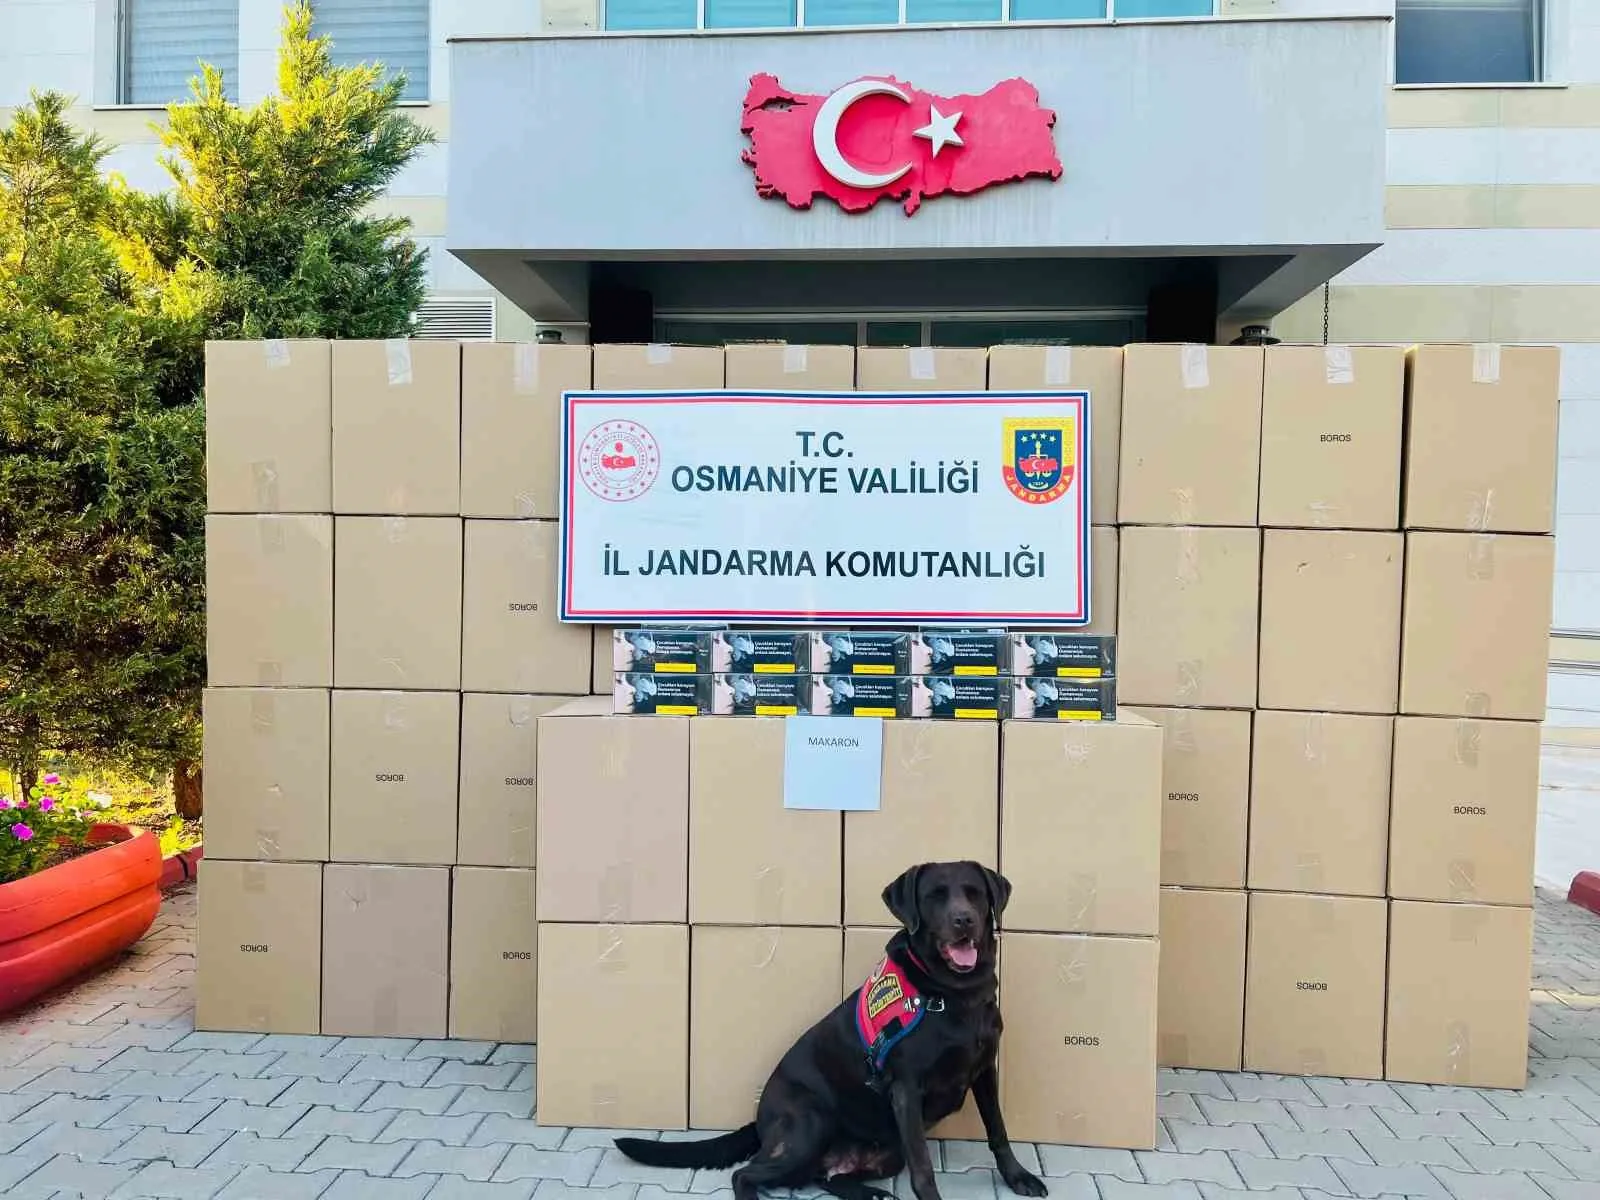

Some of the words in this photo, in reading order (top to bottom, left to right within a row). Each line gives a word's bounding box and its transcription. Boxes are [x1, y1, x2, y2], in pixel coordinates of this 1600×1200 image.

[1320, 433, 1352, 443] BOROS
[795, 431, 855, 457] T.C.
[671, 460, 838, 494] OSMANİYE
[847, 458, 980, 494] VALİLİĞİ
[1004, 474, 1072, 503] JANDARMA
[602, 543, 631, 576] İL
[638, 549, 817, 577] JANDARMA
[825, 544, 1046, 578] KOMUTANLIĞI
[508, 602, 538, 612] BOROS
[375, 773, 405, 783] BOROS
[504, 776, 534, 786] BOROS
[1168, 792, 1199, 802] BOROS
[1453, 805, 1487, 816] BOROS
[240, 943, 268, 953] BOROS
[502, 950, 532, 961] BOROS
[1296, 981, 1328, 992] BOROS
[1064, 1035, 1101, 1047] BOROS
